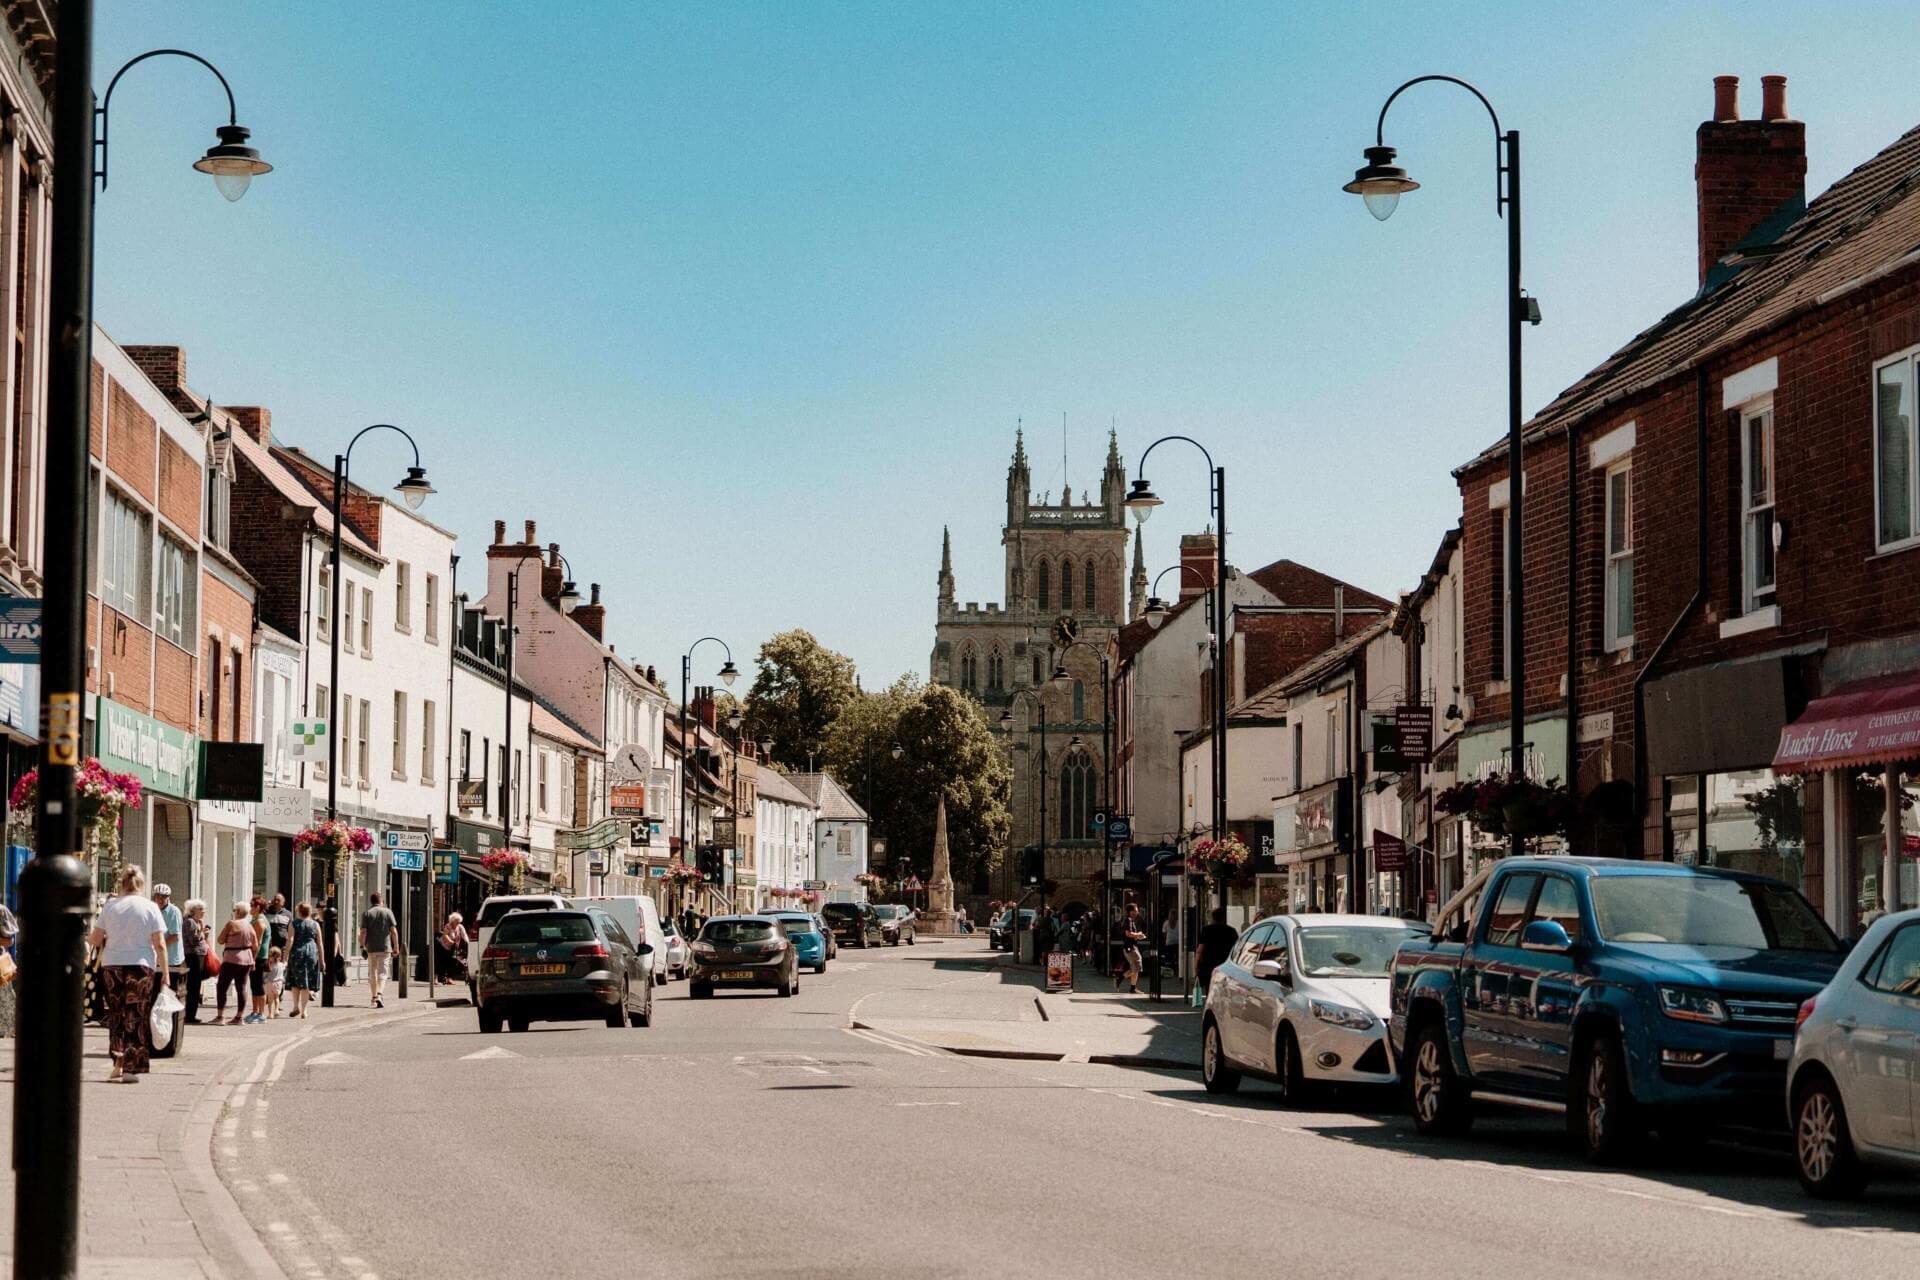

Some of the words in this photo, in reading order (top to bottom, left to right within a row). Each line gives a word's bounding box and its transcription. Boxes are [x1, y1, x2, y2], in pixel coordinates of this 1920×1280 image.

[1782, 727, 1819, 766] Lucky
[1818, 728, 1858, 754] Horse
[267, 796, 299, 805] NEW
[613, 796, 625, 804] TO
[627, 796, 641, 804] LET
[263, 807, 304, 816] LOOK
